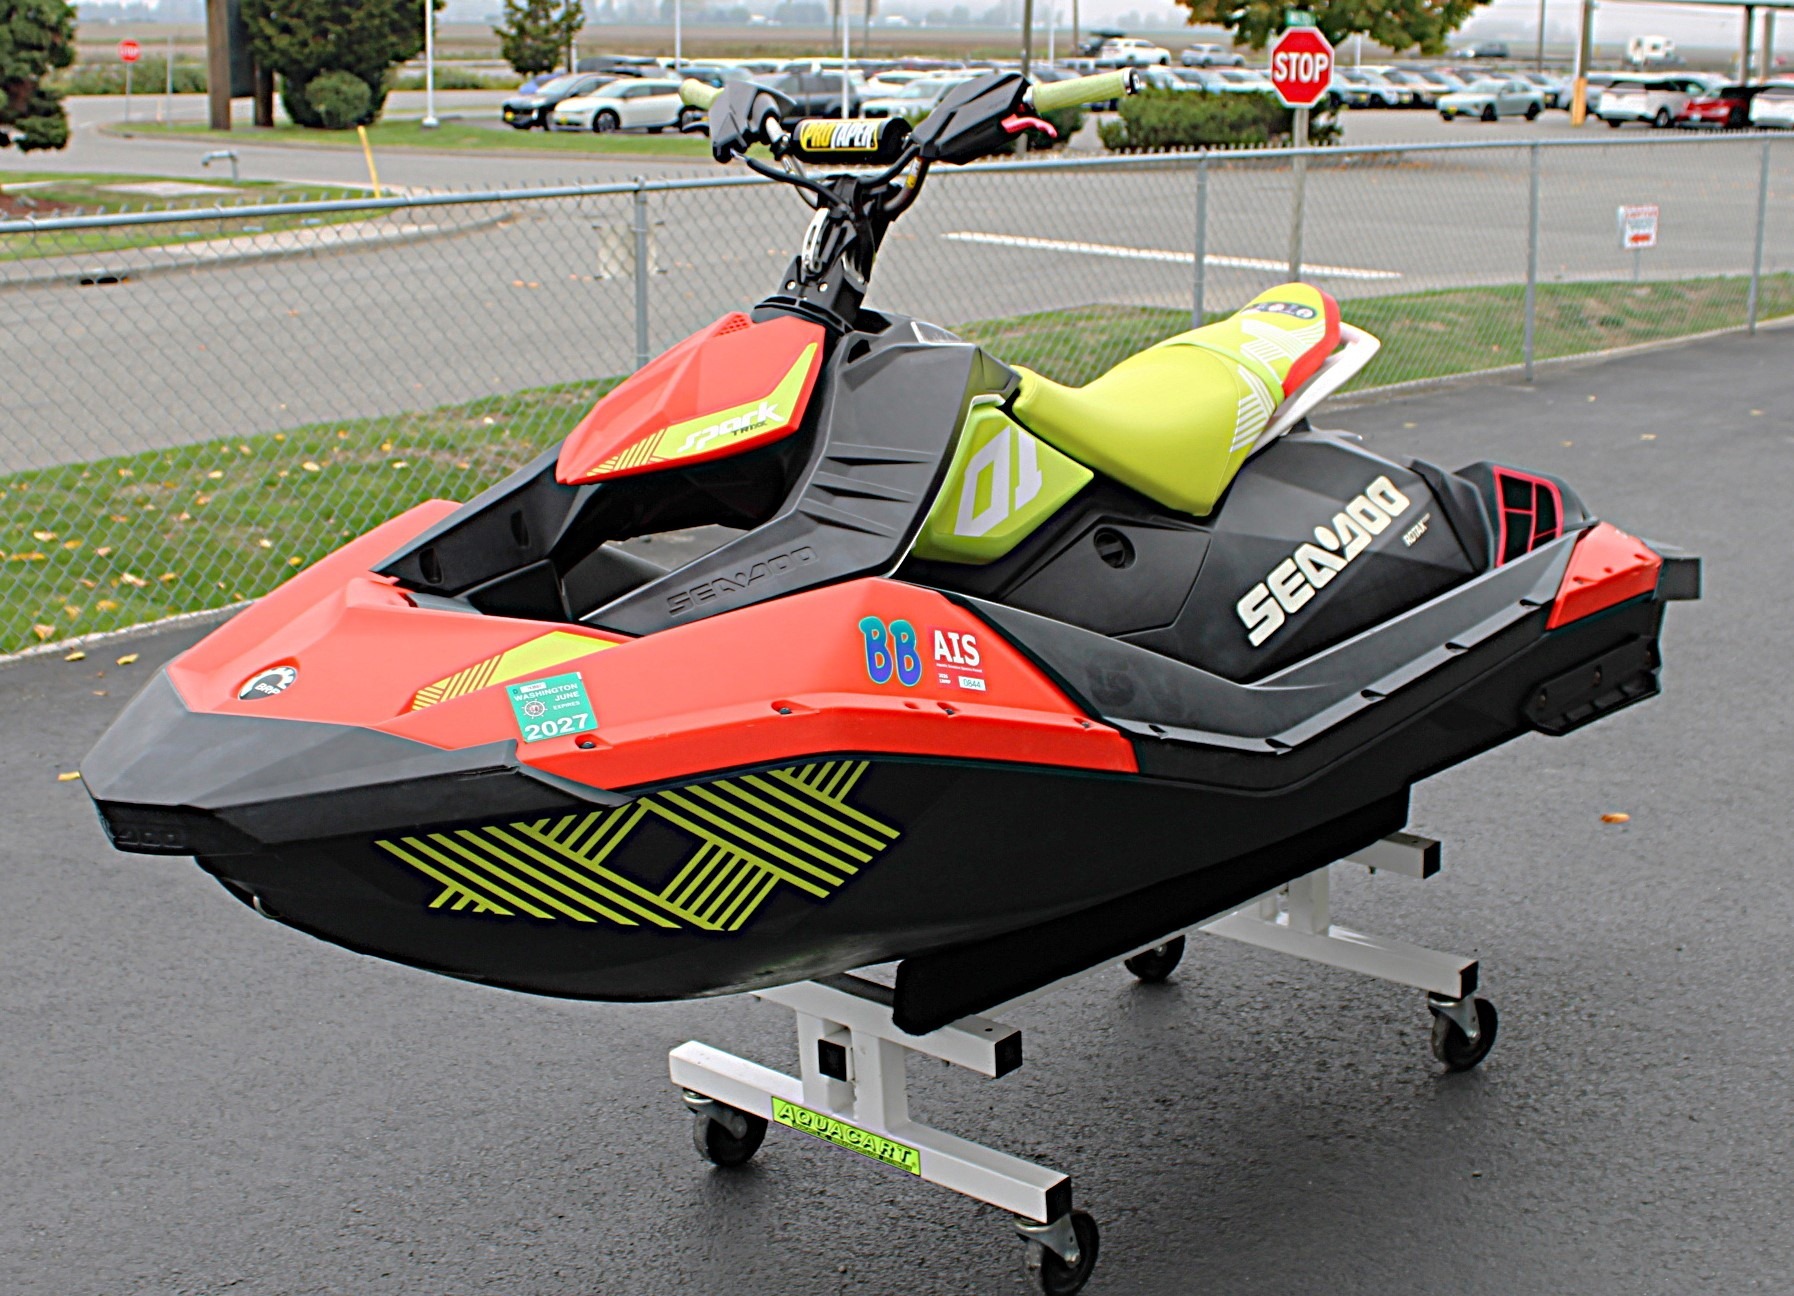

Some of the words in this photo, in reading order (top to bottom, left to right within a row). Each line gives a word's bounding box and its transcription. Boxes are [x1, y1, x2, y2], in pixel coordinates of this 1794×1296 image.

[1273, 52, 1329, 83] STOP
[934, 629, 980, 667] AIS
[254, 682, 281, 695] BRP
[514, 683, 579, 702] WASHINGTON
[963, 678, 981, 688] 0844
[553, 700, 580, 711] EXPIRES
[554, 691, 580, 702] JUNE
[524, 713, 588, 740] 2027
[779, 1103, 912, 1164] AQUACART
